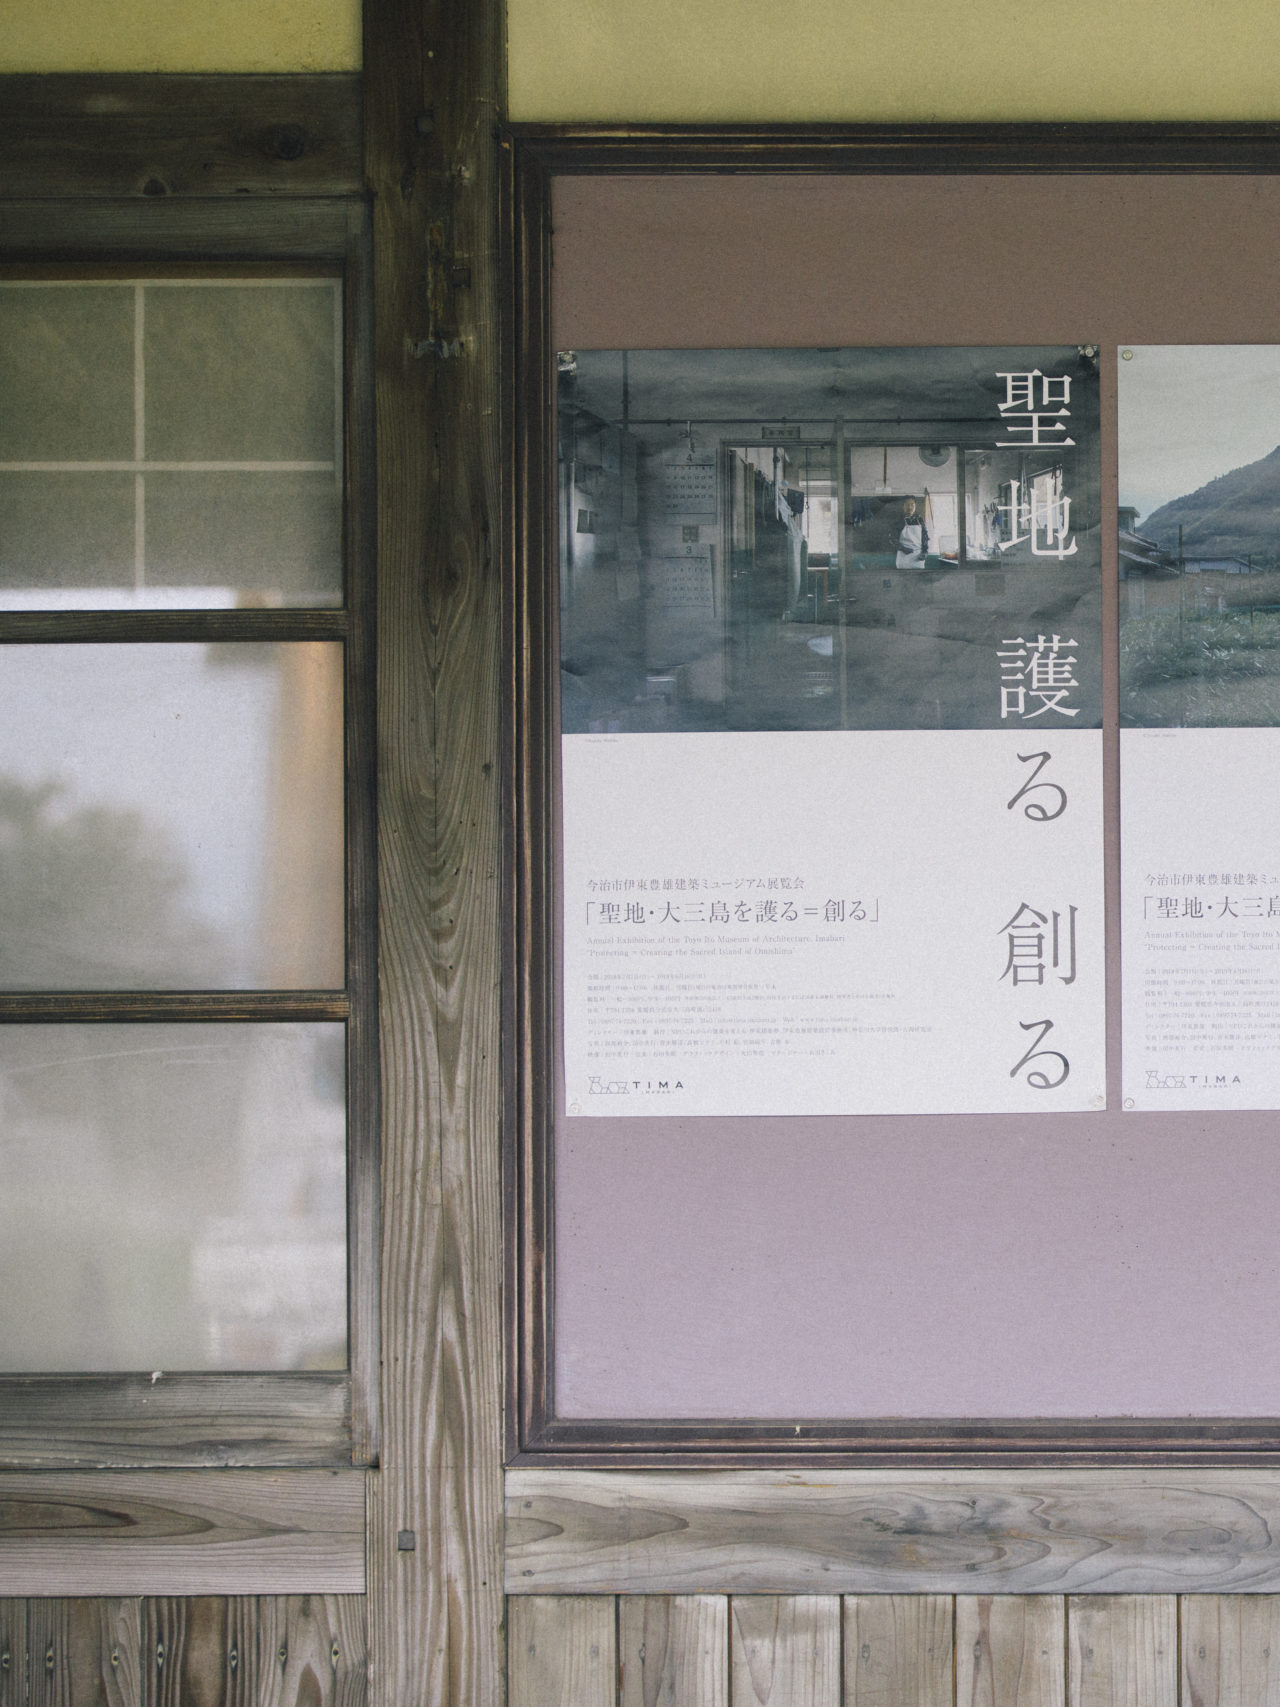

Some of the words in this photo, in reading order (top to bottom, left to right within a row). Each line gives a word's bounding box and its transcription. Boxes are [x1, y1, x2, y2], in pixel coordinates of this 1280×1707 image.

[994, 368, 1079, 561] 聖地
[587, 876, 806, 892] 今治市伊東豊雄建築ミュージアム展覧会
[997, 902, 1079, 1090] 創る
[632, 1081, 685, 1089] TIMA
[1189, 1075, 1241, 1084] TIMA
